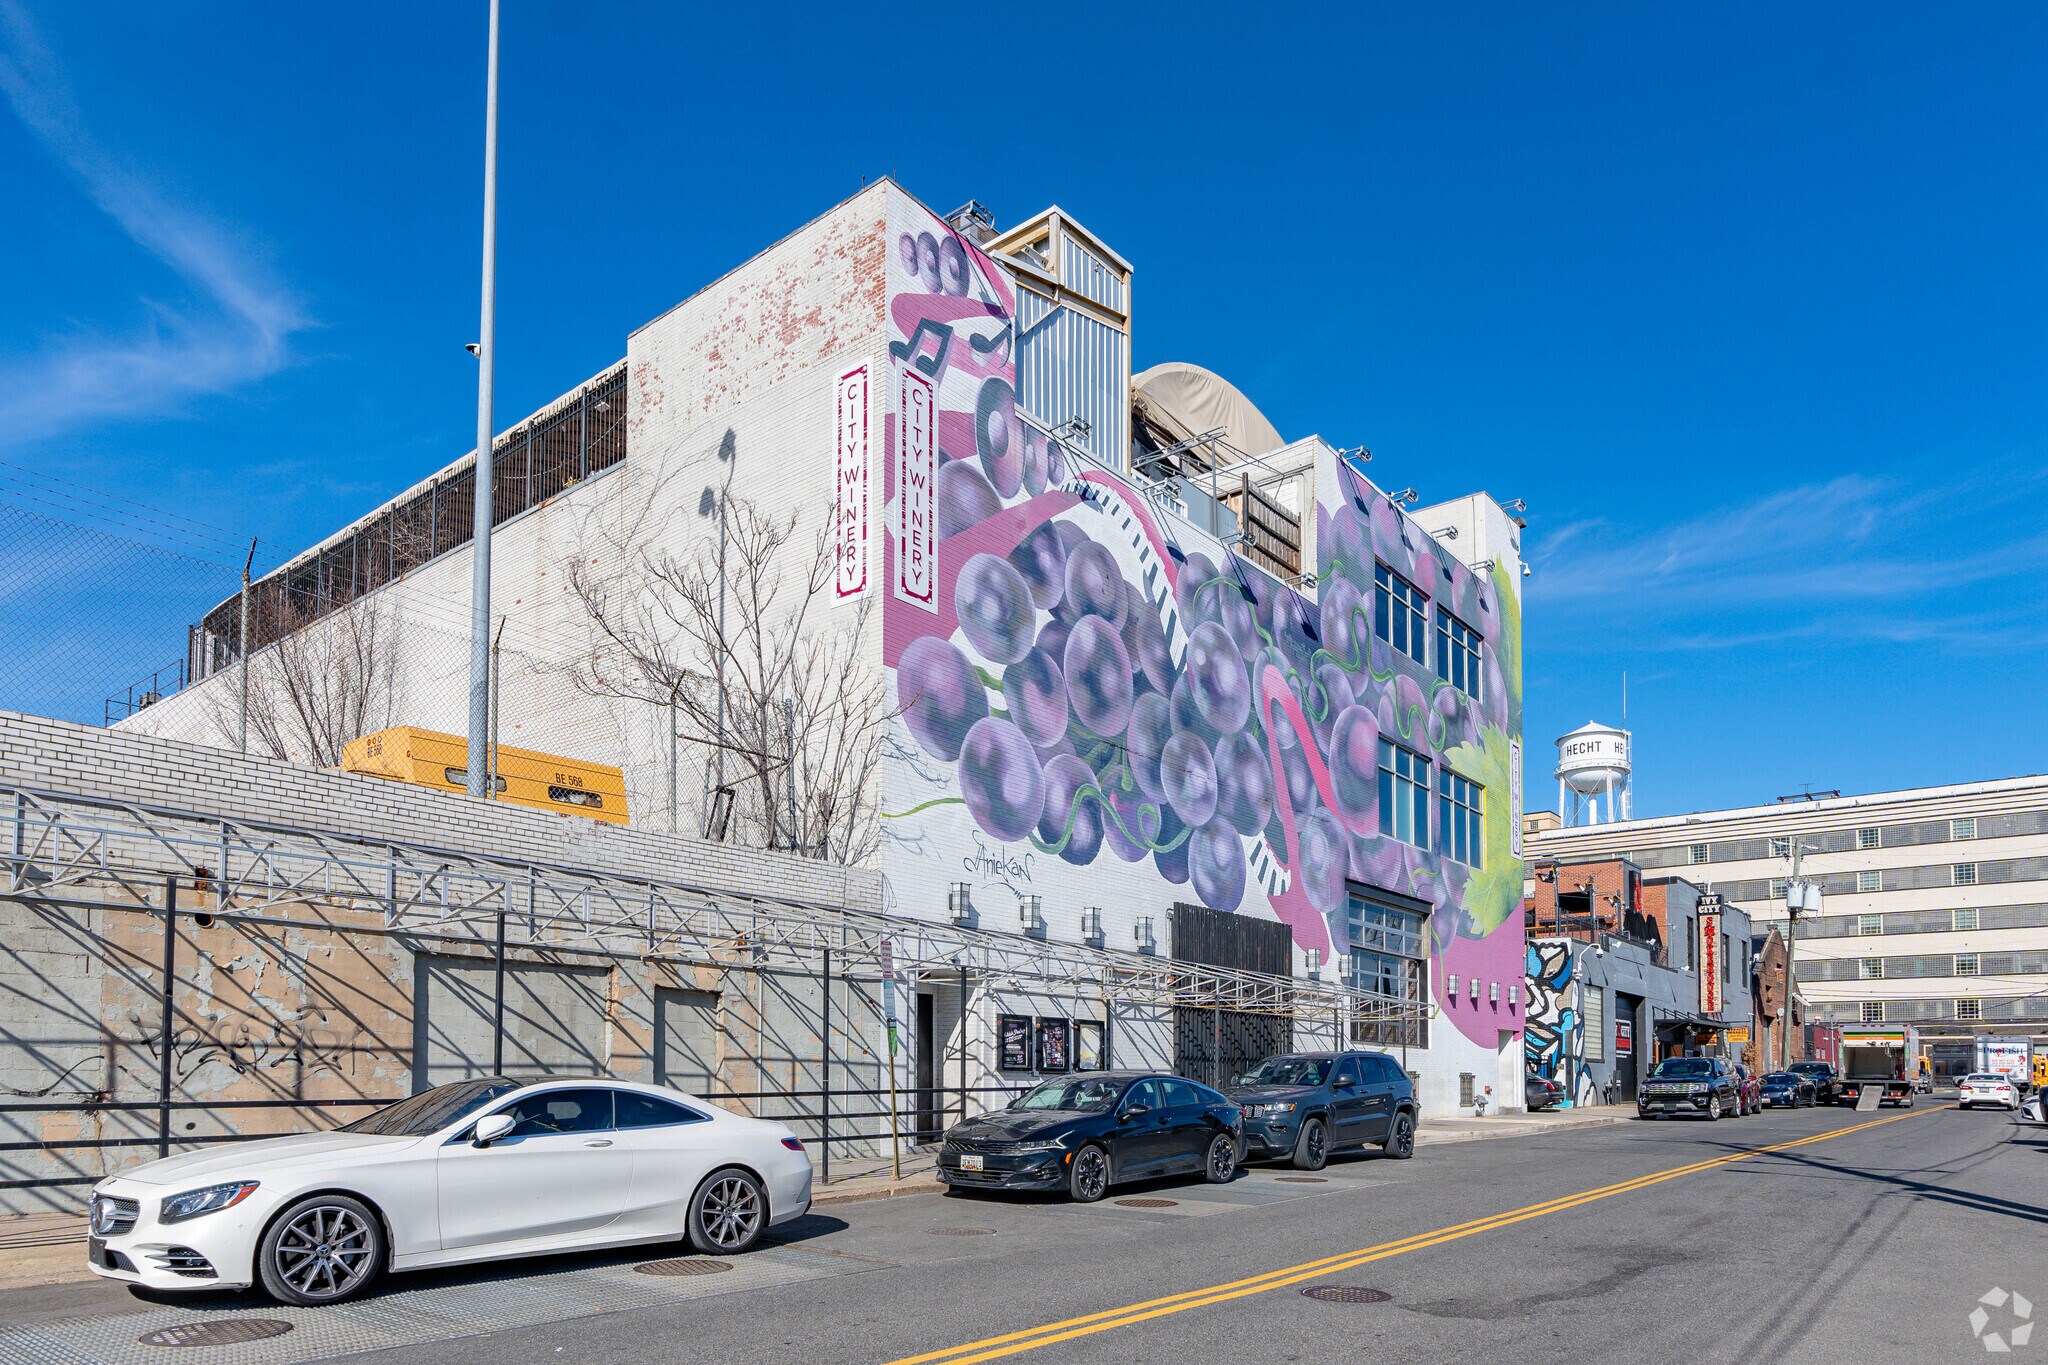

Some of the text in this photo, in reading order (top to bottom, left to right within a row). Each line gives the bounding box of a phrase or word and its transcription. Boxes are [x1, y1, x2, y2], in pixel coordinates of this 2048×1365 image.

[844, 383, 860, 581] CITY WINERY
[909, 388, 925, 586] CITY WINERY
[1566, 741, 1602, 756] HECHT
[555, 772, 583, 787] BE 568
[1701, 896, 1719, 905] IVY
[1698, 904, 1721, 913] CITY
